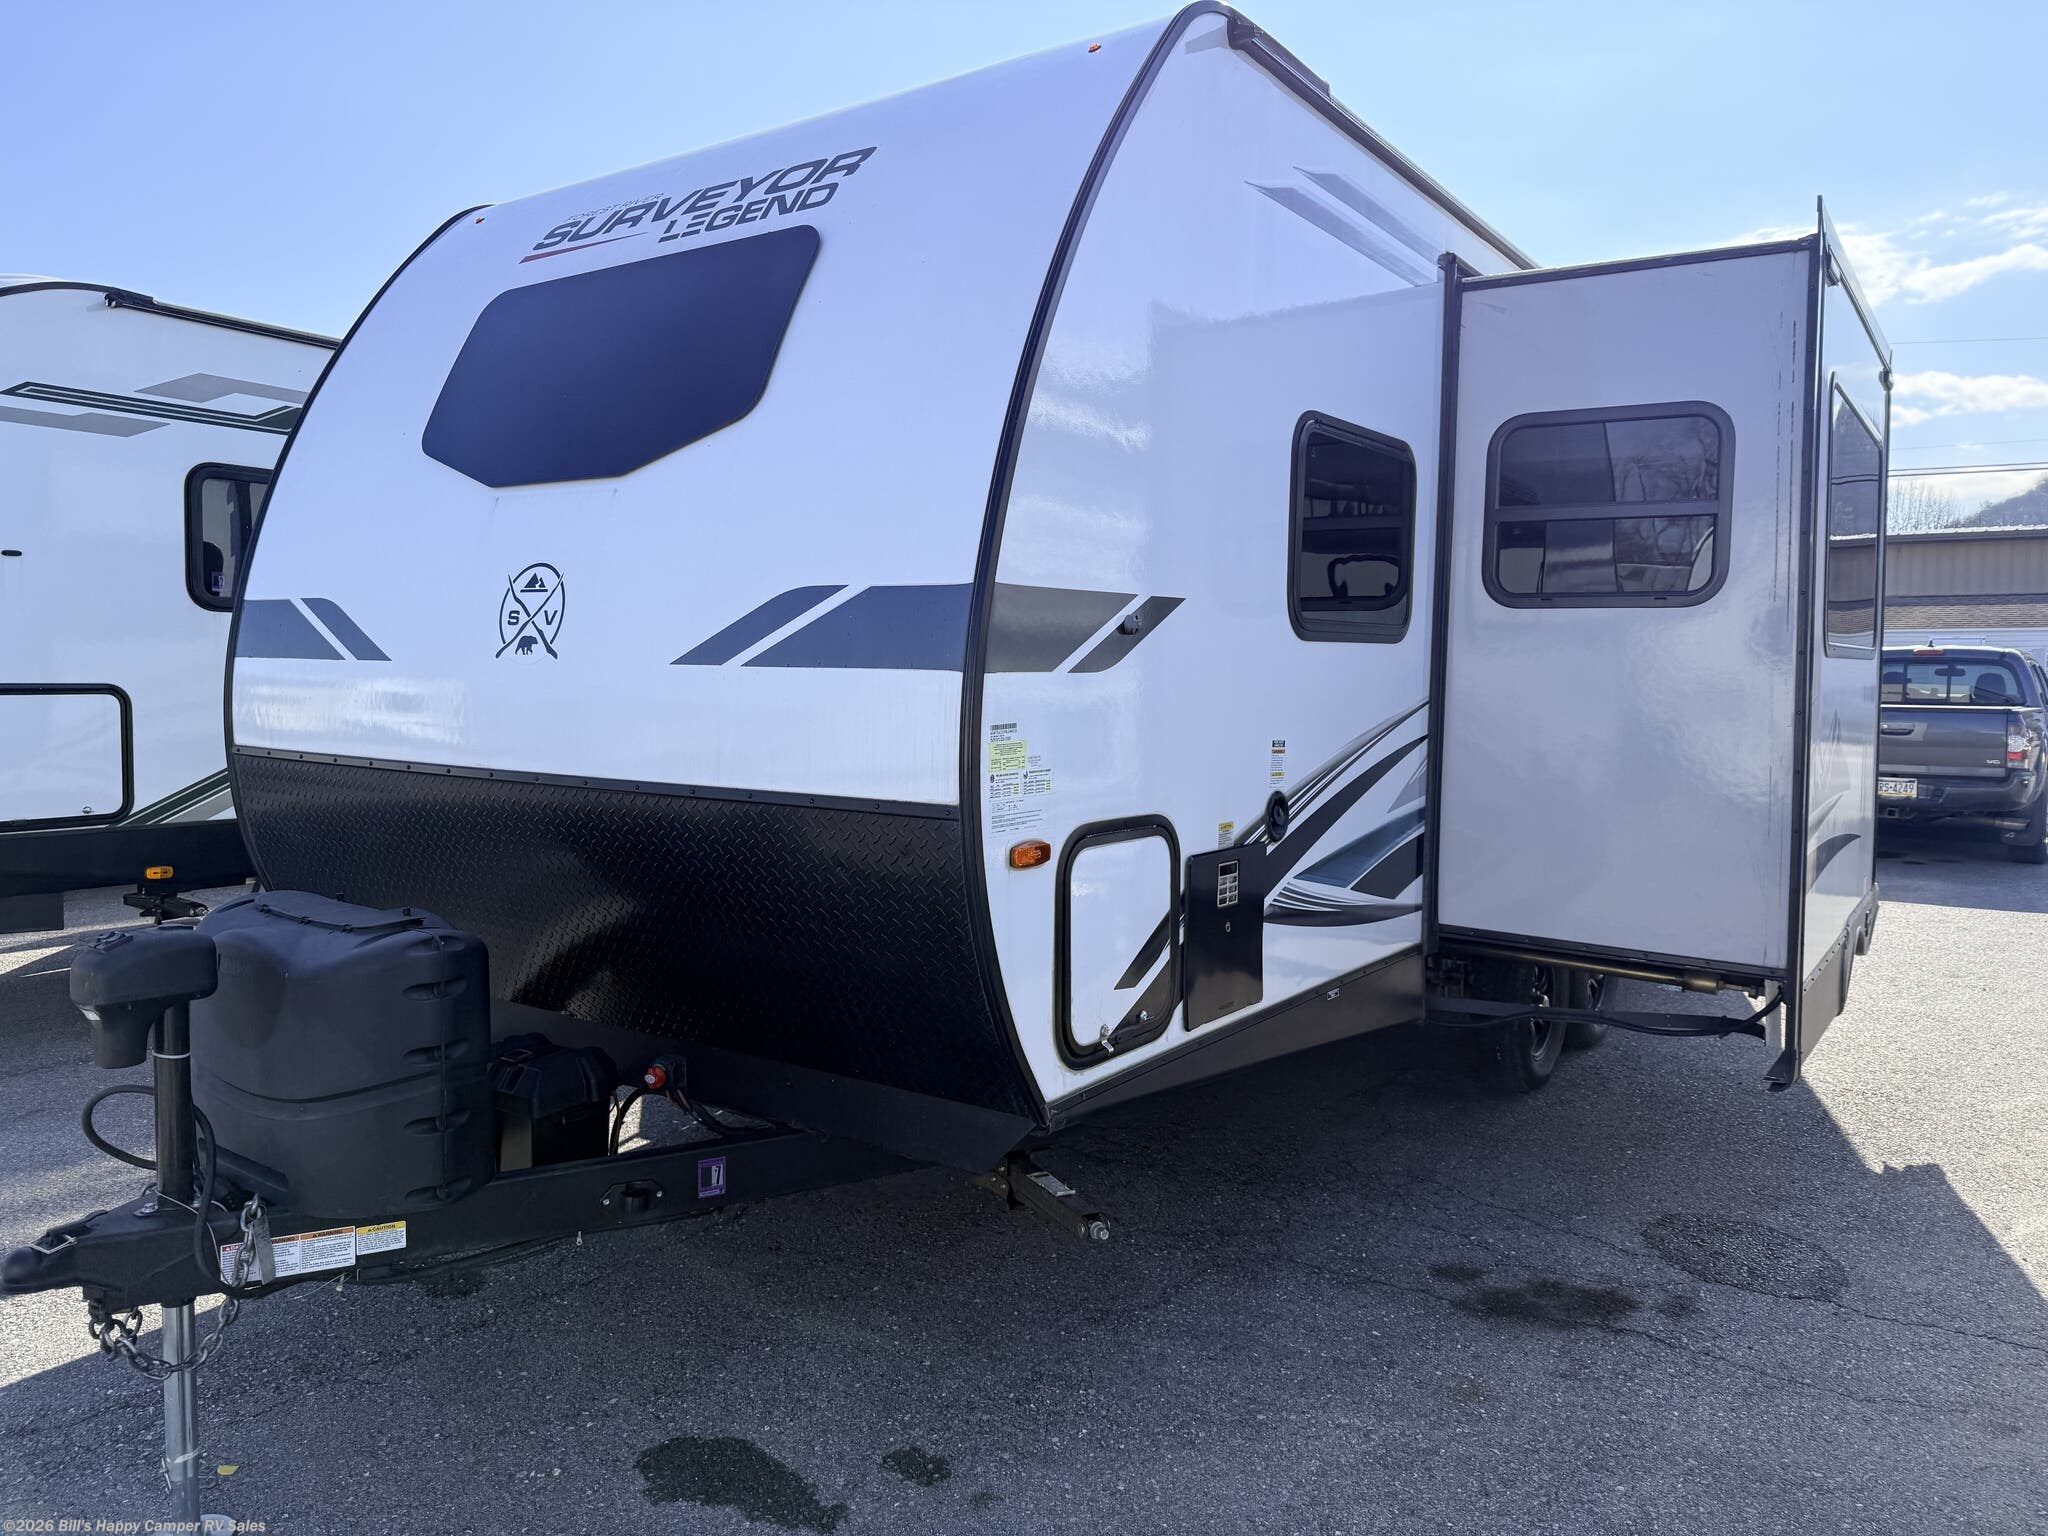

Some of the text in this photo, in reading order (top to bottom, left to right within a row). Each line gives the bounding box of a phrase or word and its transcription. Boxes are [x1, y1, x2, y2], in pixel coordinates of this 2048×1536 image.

[533, 146, 877, 251] SURVEYOR
[658, 182, 839, 243] LEGEND
[507, 610, 558, 625] S V
[316, 1229, 343, 1237] WARNING
[372, 1224, 396, 1232] CAUTION
